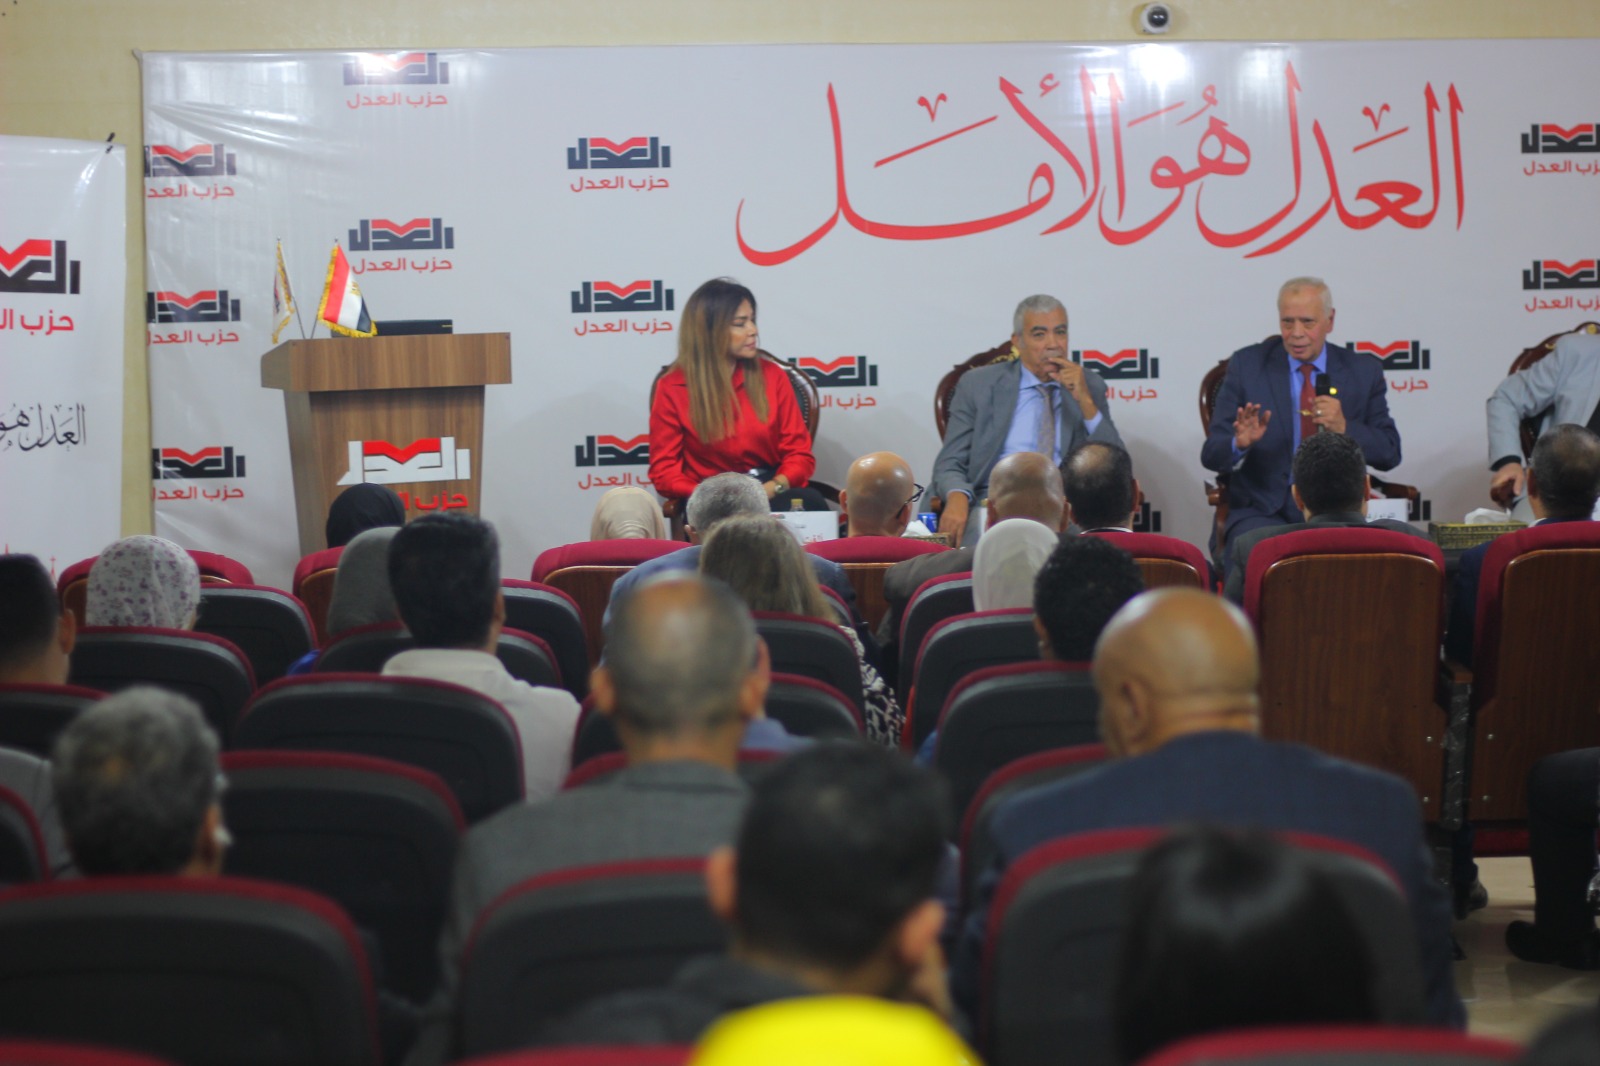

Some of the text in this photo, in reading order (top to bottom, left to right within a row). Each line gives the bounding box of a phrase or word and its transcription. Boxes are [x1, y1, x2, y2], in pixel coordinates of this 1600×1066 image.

[346, 92, 449, 110] حزب العدل
[1523, 160, 1600, 177] زب العدل
[144, 183, 235, 200] حزب العد
[570, 175, 669, 193] حزب العدل
[352, 256, 453, 275] حزب العدل
[1524, 295, 1600, 313] زب العدل
[20, 309, 75, 336] حزب
[574, 318, 674, 336] حزب العدل
[197, 328, 240, 346] حزب
[1391, 376, 1429, 393] حزب
[836, 393, 877, 410] حزب
[1118, 386, 1158, 402] حزب
[578, 472, 632, 490] العدل
[202, 485, 244, 502] حزب
[415, 490, 469, 512] حزب
